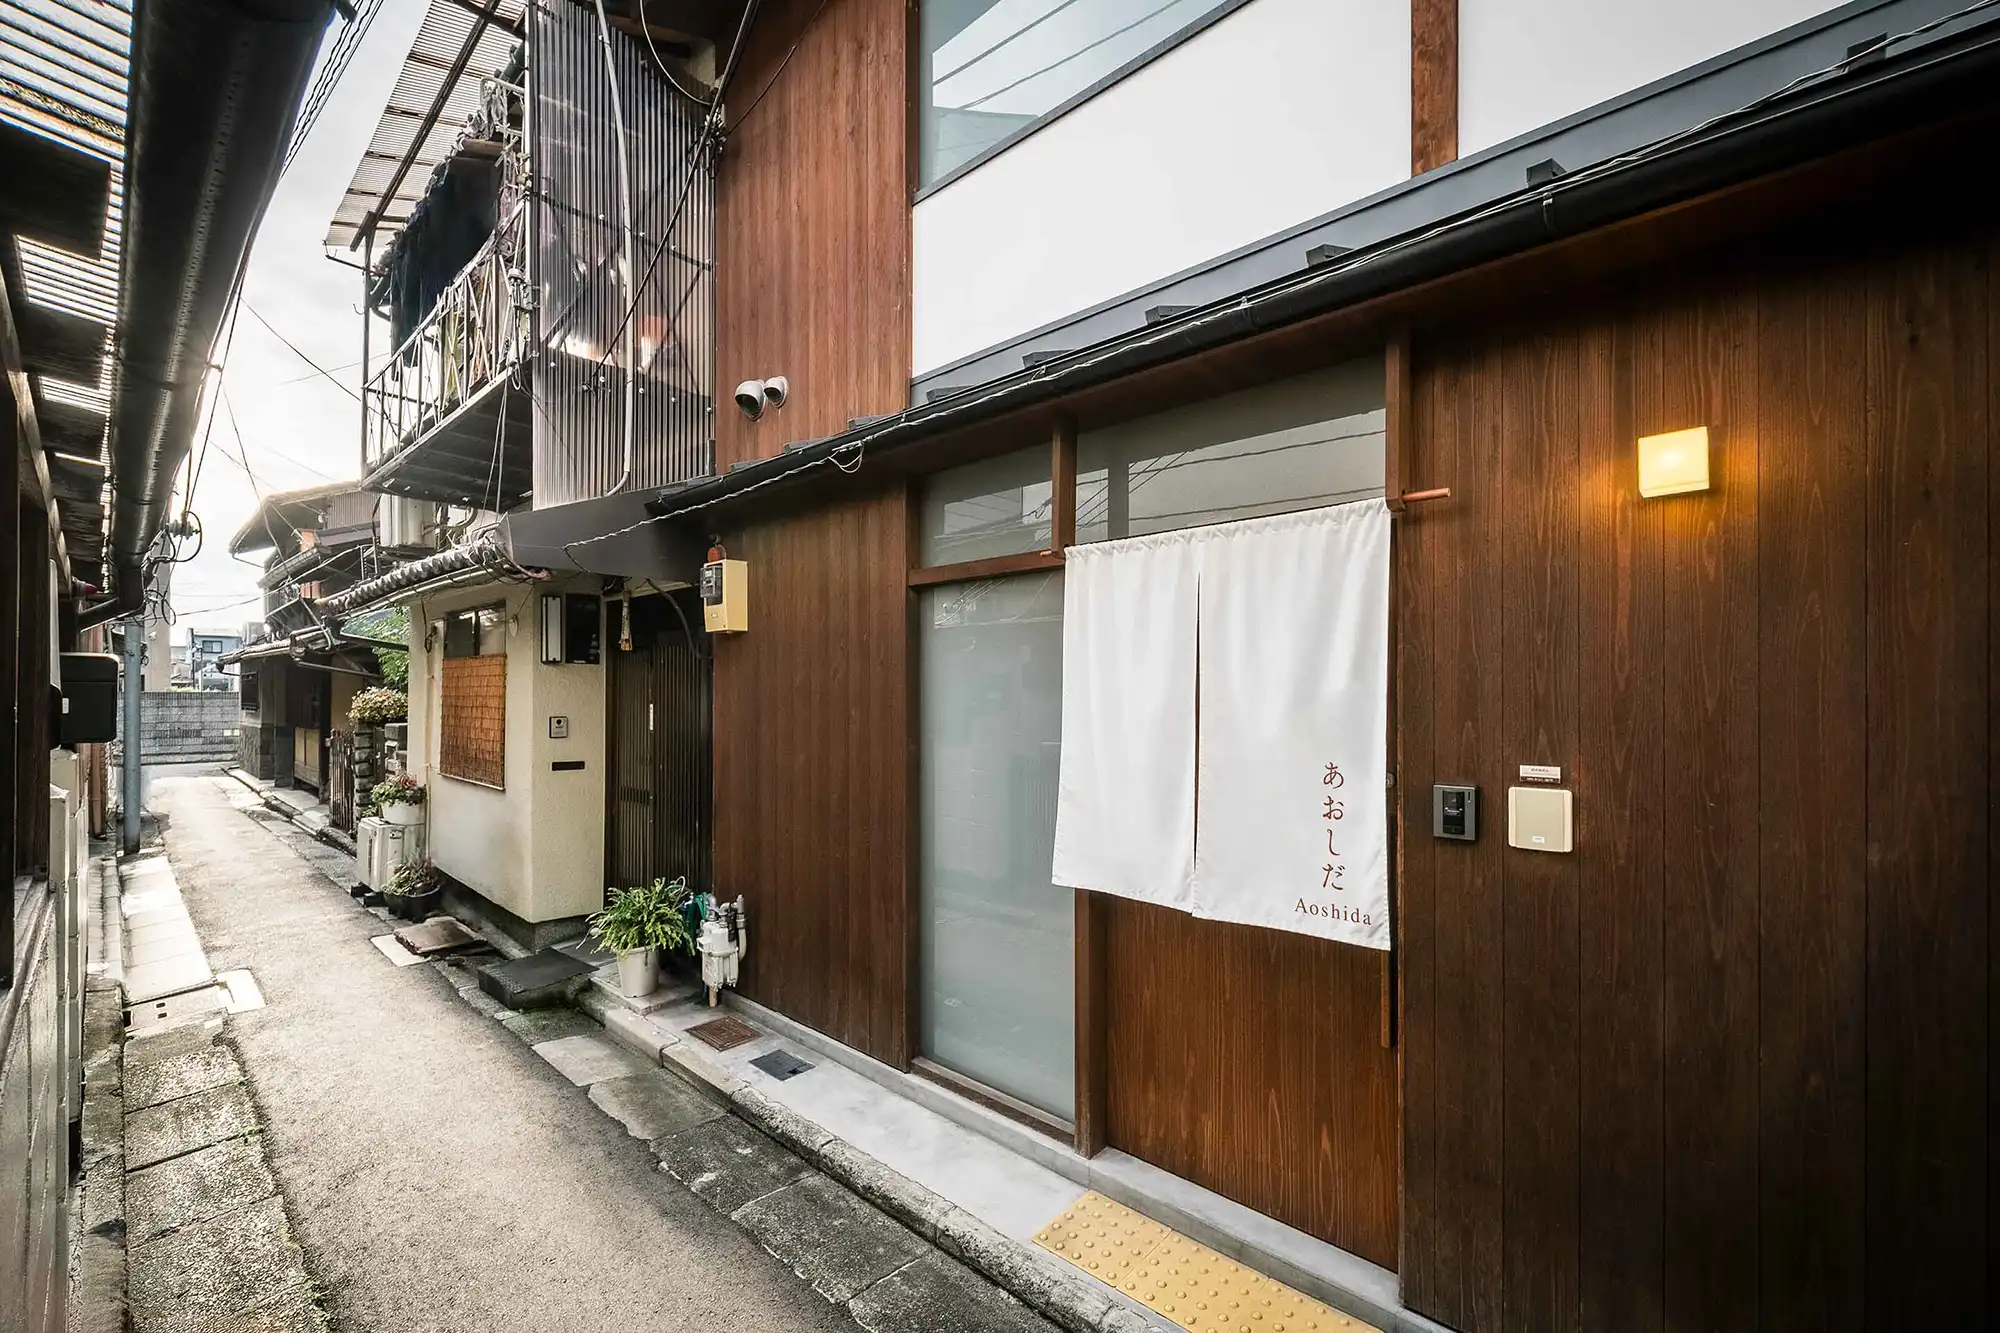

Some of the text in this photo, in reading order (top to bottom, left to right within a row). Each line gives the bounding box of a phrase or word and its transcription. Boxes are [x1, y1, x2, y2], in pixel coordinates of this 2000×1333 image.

[1322, 761, 1345, 891] あおしだ
[1294, 897, 1372, 926] Aoshida
